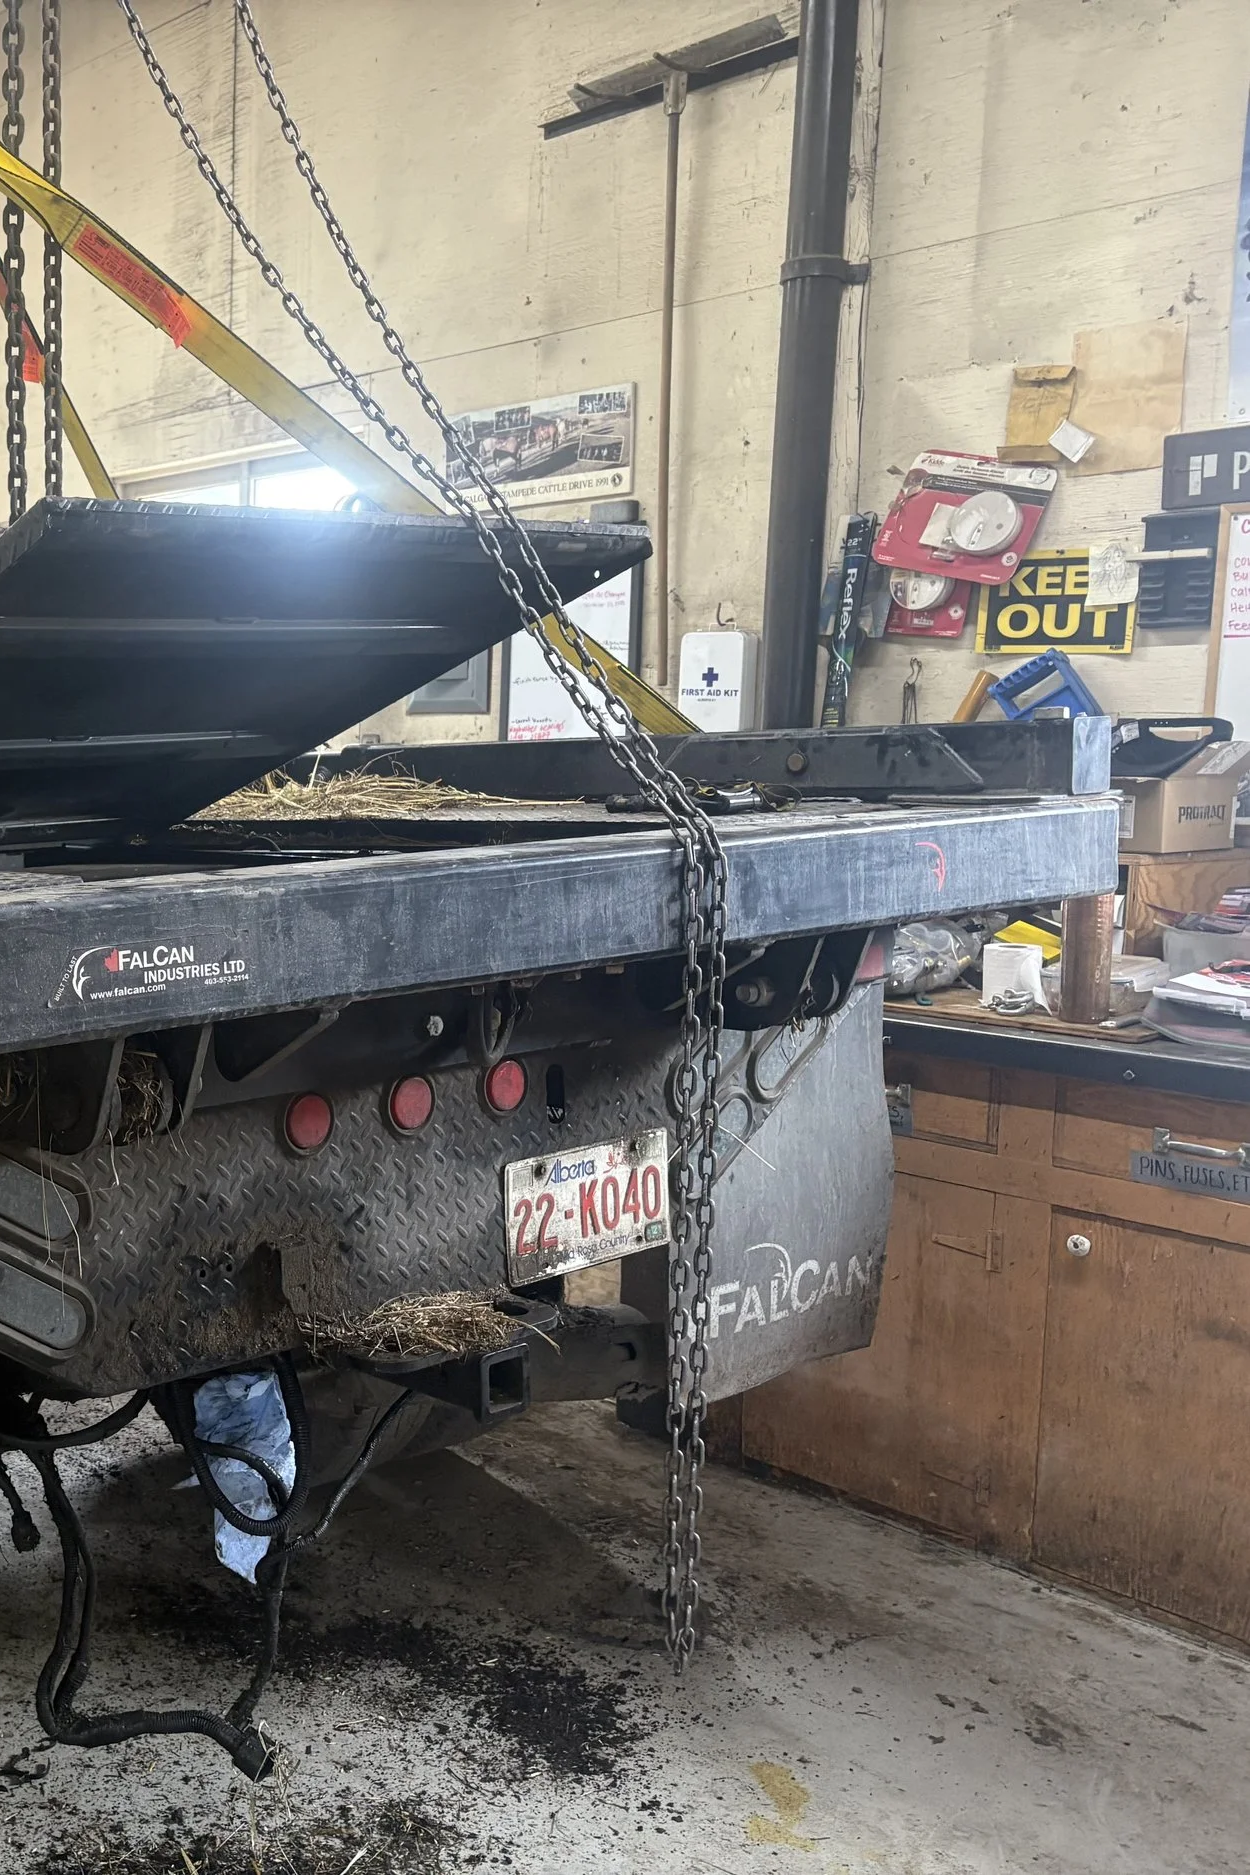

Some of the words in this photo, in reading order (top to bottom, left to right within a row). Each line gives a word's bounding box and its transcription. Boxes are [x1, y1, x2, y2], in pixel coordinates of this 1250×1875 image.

[501, 487, 537, 499] TAMPEDE
[537, 483, 567, 494] CATTLE
[568, 480, 593, 490] DRIVE
[595, 477, 609, 486] 1991
[999, 564, 1090, 597] KEE
[837, 567, 858, 640] Reflex
[996, 603, 1119, 639] OUT
[681, 688, 705, 696] FIRST
[706, 688, 721, 697] AID
[723, 689, 739, 697] KIT
[118, 945, 194, 972] FALCAN
[144, 962, 221, 984] INDUSTRIES
[223, 959, 246, 974] LTD
[54, 980, 67, 1002] BUILT
[67, 955, 78, 974] LAST
[90, 983, 166, 1000] www.falcan.com
[545, 1158, 595, 1186] Alberta
[599, 1233, 630, 1250] Country
[709, 1254, 873, 1339] FALCAN
